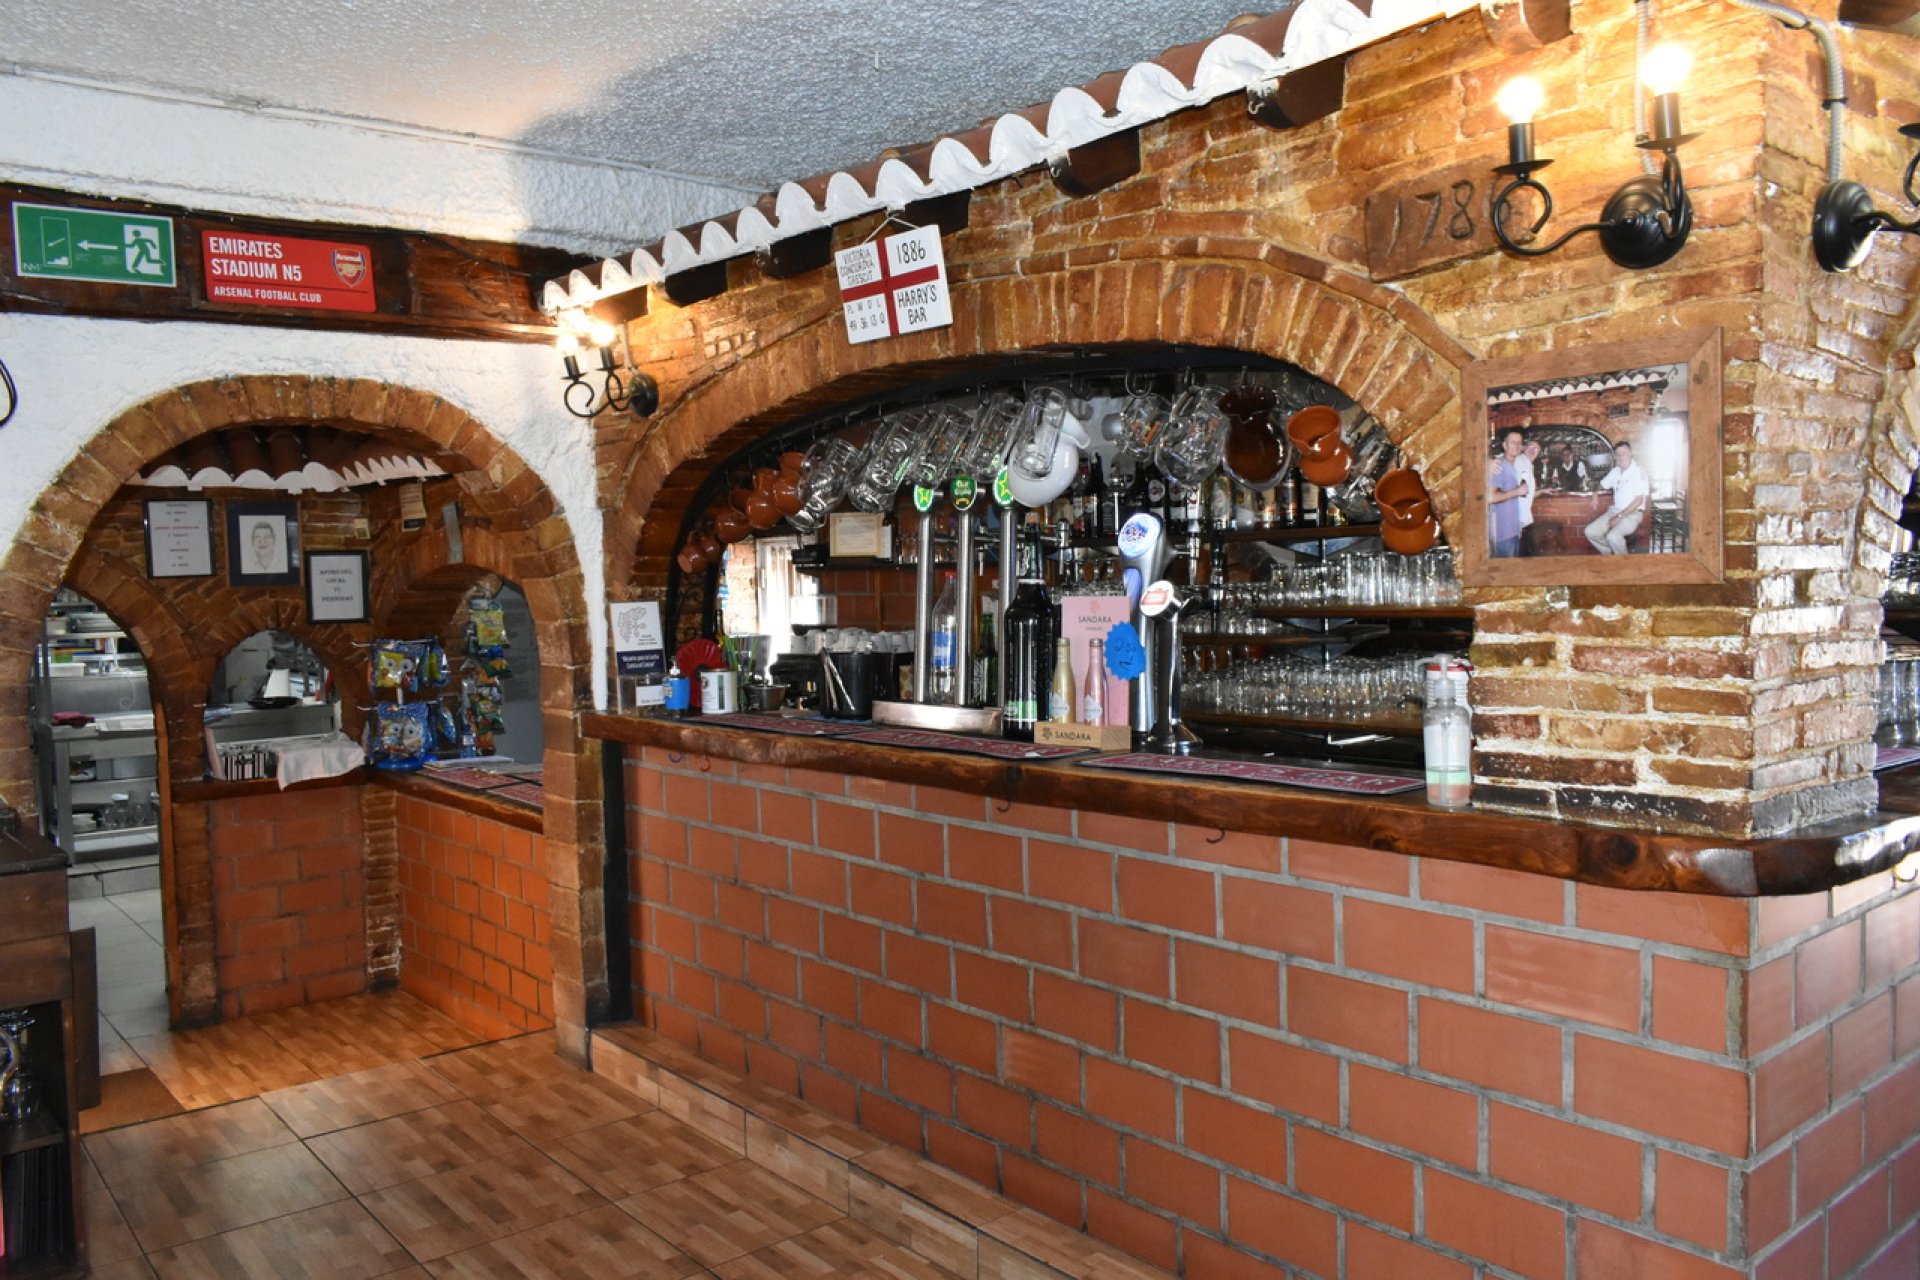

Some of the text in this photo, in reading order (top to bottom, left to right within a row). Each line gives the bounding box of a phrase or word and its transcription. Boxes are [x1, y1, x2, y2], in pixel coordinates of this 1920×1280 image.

[209, 236, 283, 259] EMIRATES
[896, 240, 926, 264] 1886
[211, 257, 303, 282] STADIUM N5
[214, 286, 322, 303] ARSENAL FOOTBALL CLUB
[896, 284, 937, 308] HARRY'S
[907, 307, 928, 325] BAR
[1078, 615, 1113, 624] SANDARA
[1055, 729, 1091, 742] SANDARA
